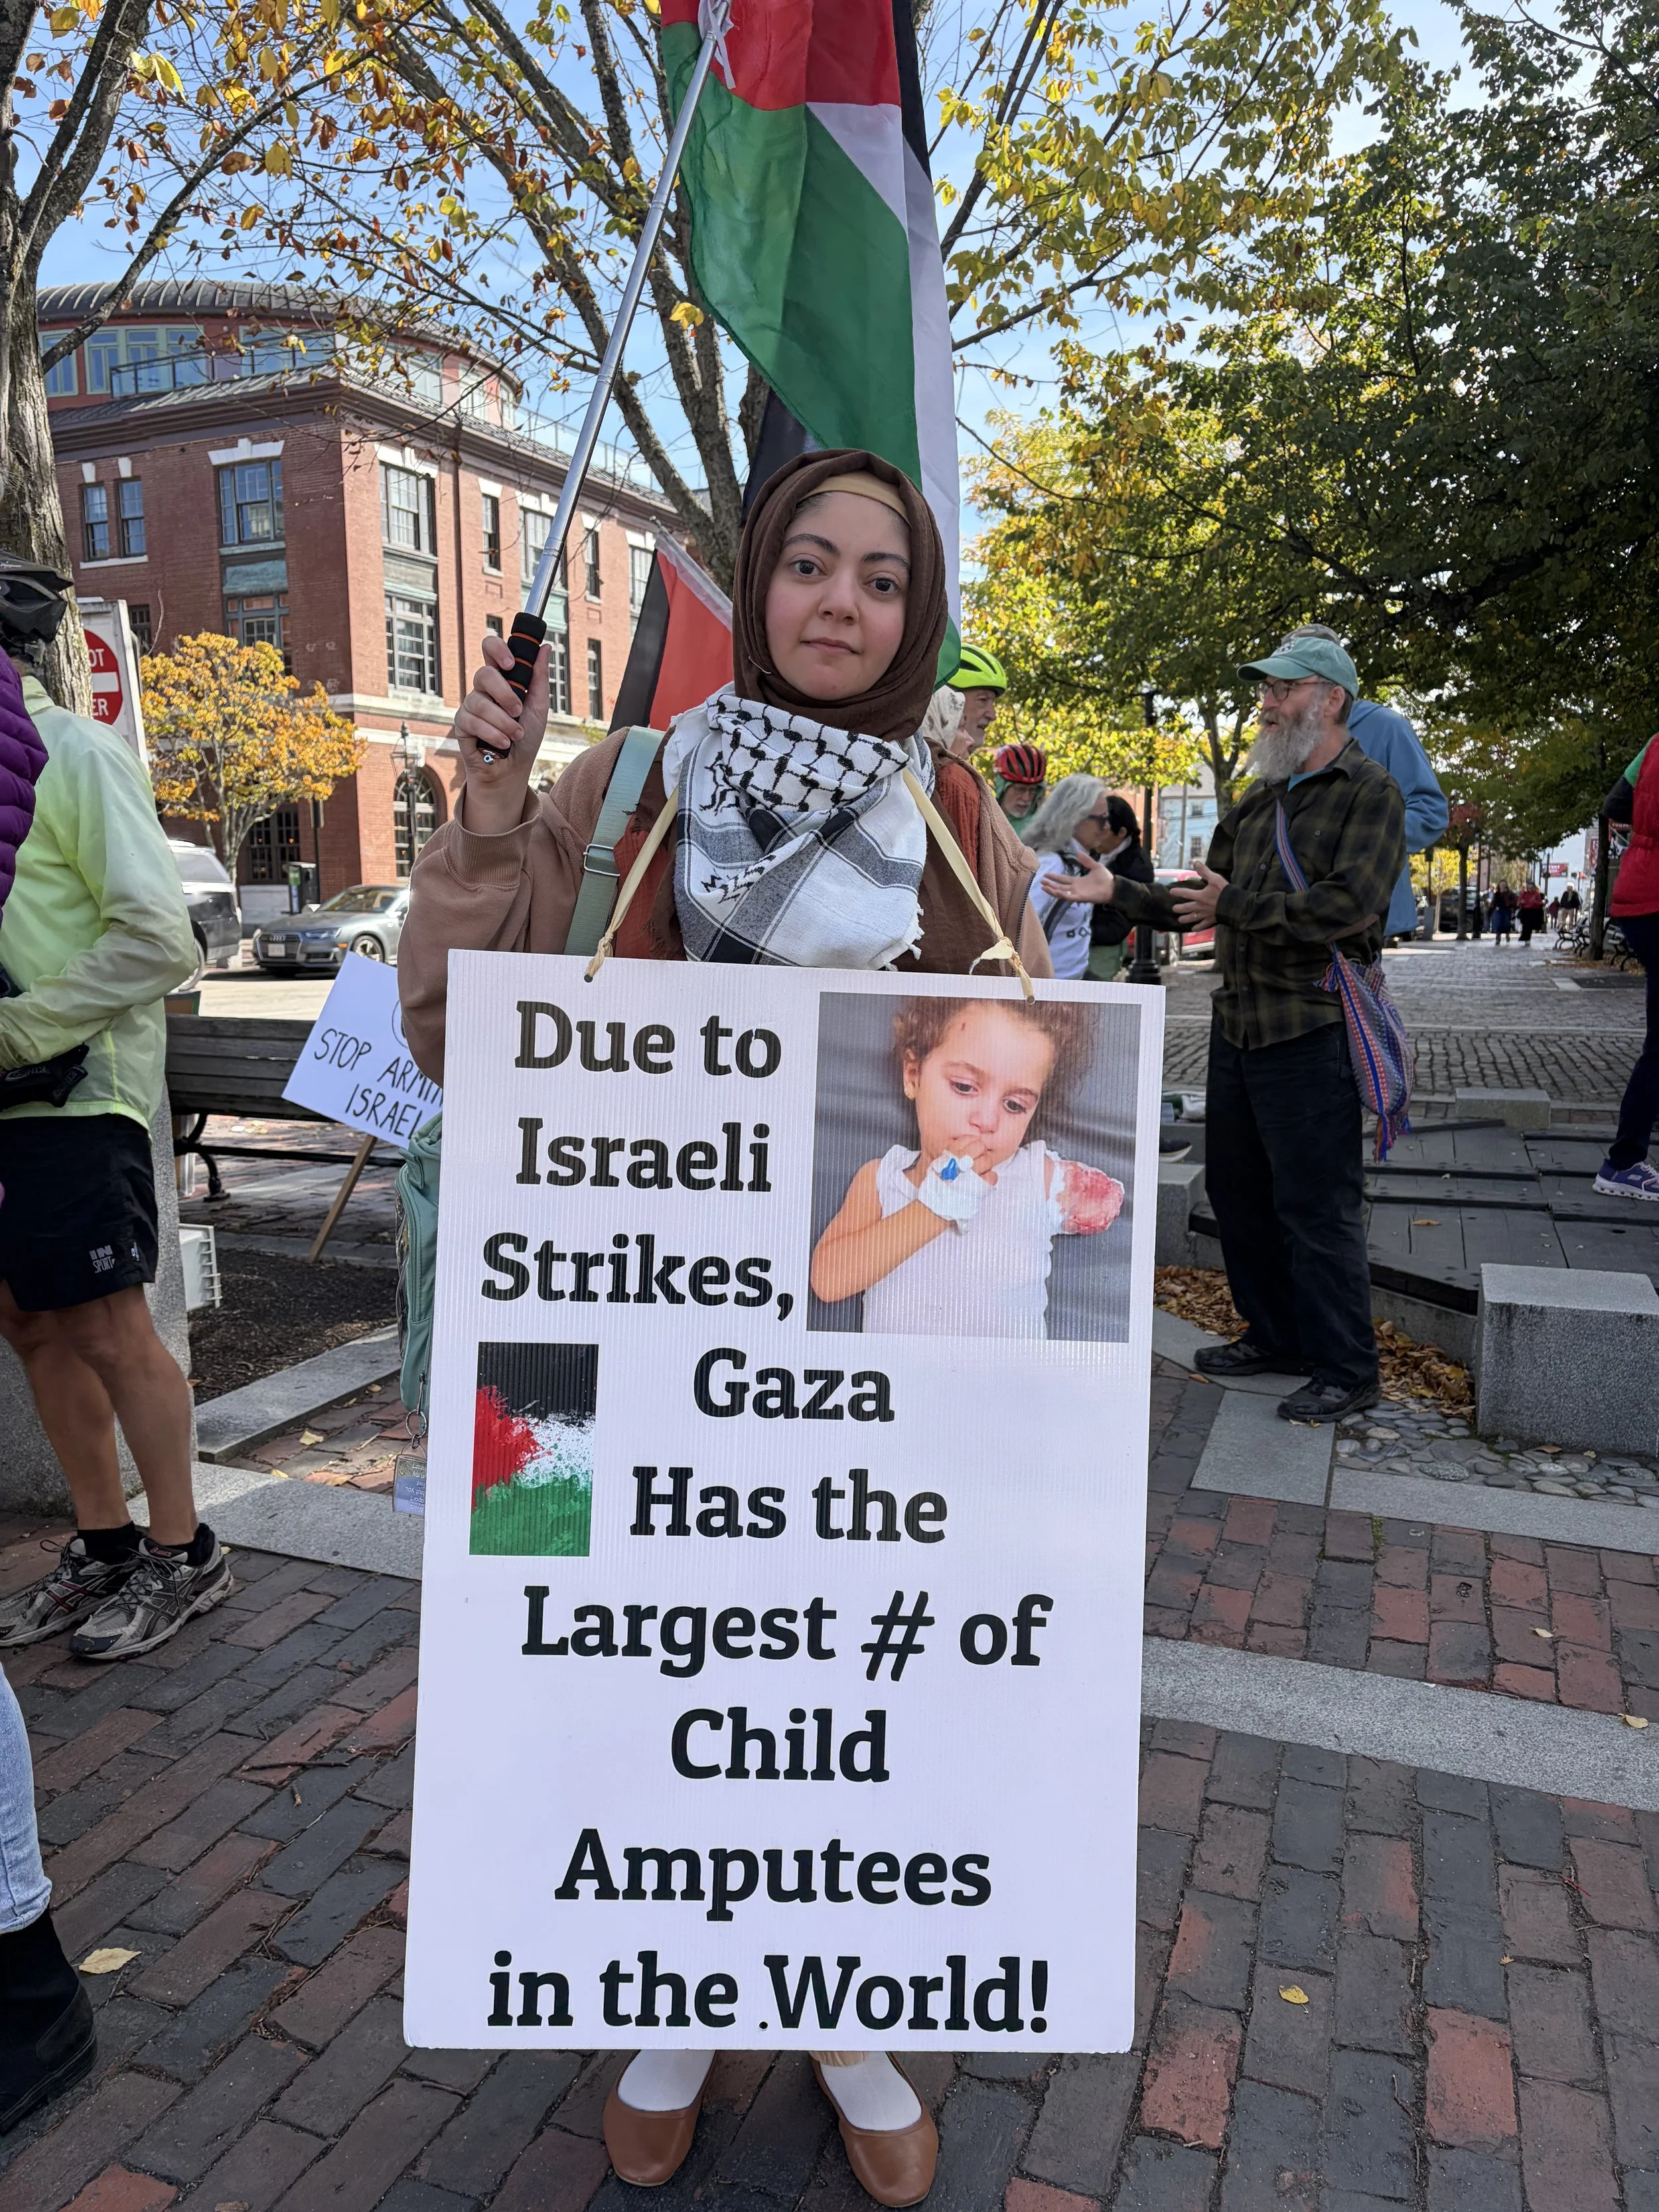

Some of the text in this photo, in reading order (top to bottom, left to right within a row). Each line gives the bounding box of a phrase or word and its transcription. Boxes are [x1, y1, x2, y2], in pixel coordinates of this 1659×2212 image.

[89, 648, 105, 668] OT
[314, 1028, 372, 1071] STOP
[514, 1000, 782, 1078] Due to
[344, 1084, 423, 1140] ISRAEL
[516, 1117, 772, 1193] Israeli
[89, 1244, 113, 1260] IN
[93, 1256, 113, 1274] SPORT
[481, 1232, 794, 1322] Strikes,
[693, 1347, 895, 1422] Gaza
[630, 1466, 948, 1544] Has the
[522, 1585, 1054, 1682] Largest # of
[671, 1706, 890, 1783] Child
[554, 1828, 991, 1922] Amputees
[487, 1950, 1048, 2033] in the World!
